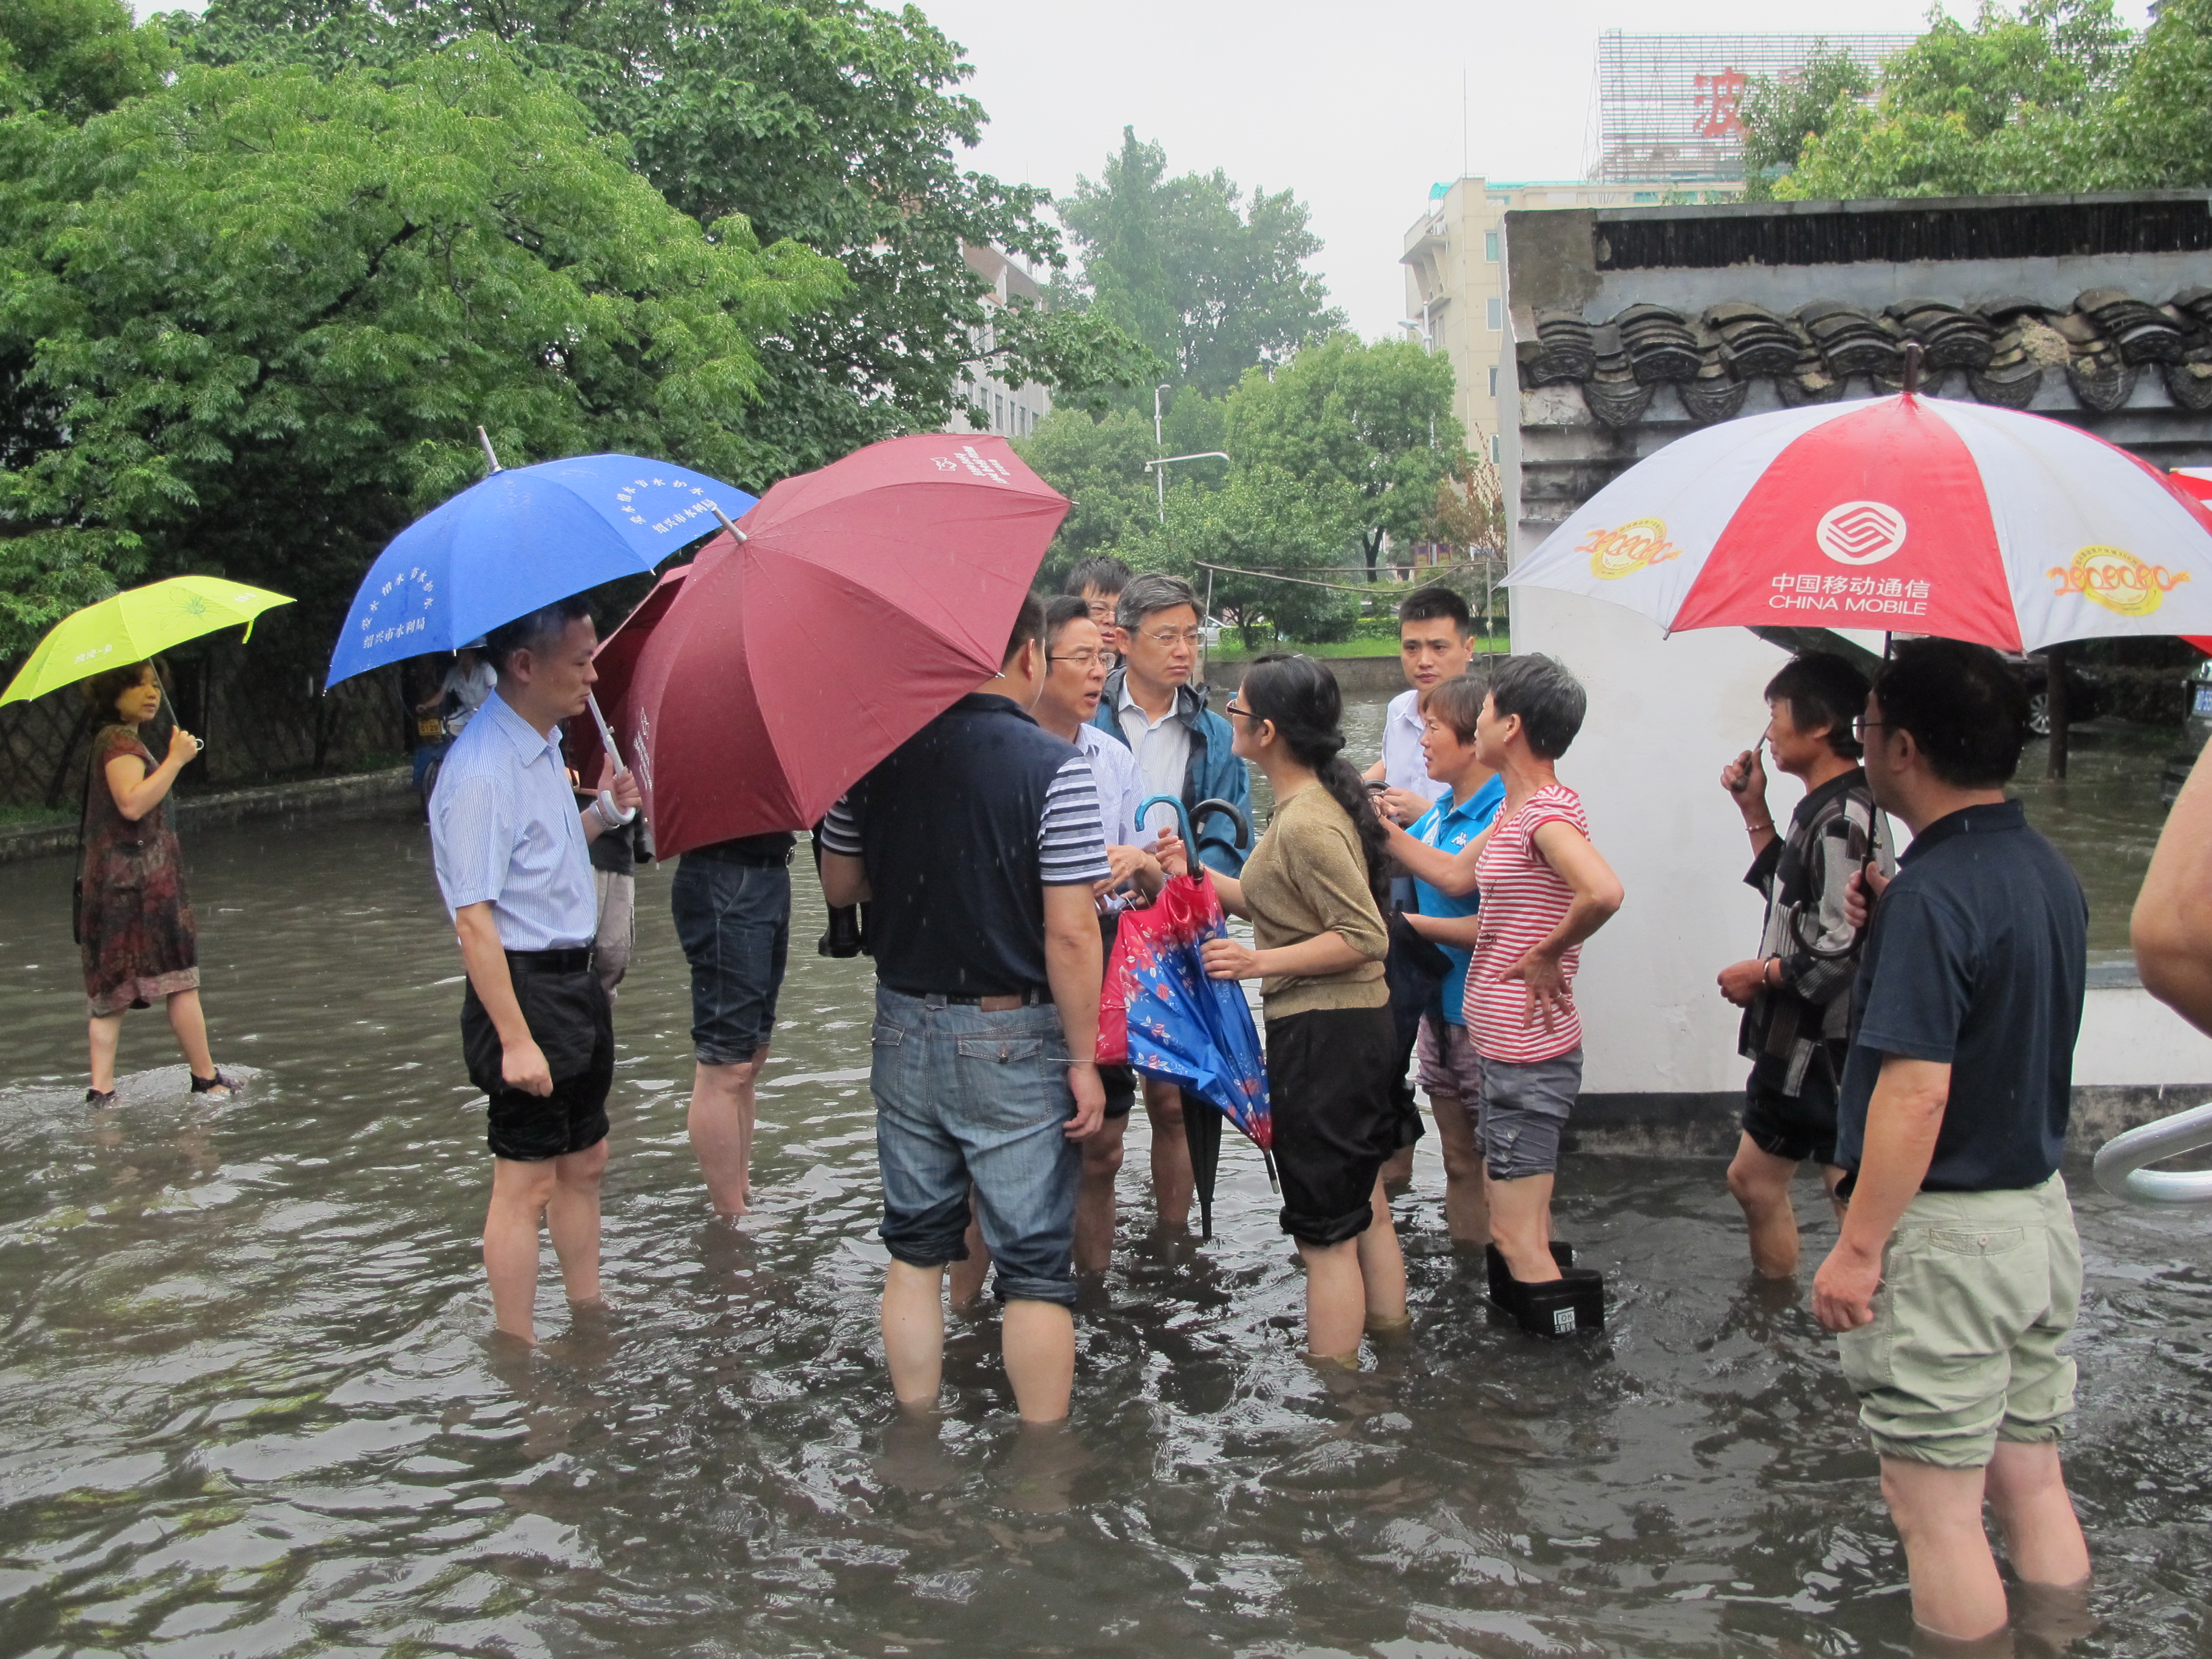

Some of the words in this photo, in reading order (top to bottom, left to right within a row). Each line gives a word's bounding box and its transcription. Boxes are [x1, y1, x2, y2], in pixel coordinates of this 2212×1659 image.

[652, 498, 718, 534] 绍兴市水利局
[1772, 573, 1930, 598] 中国移动通信
[1769, 595, 1838, 611] CHINA
[1845, 598, 1928, 615] MOBILE
[364, 617, 425, 649] 绍兴市水利局
